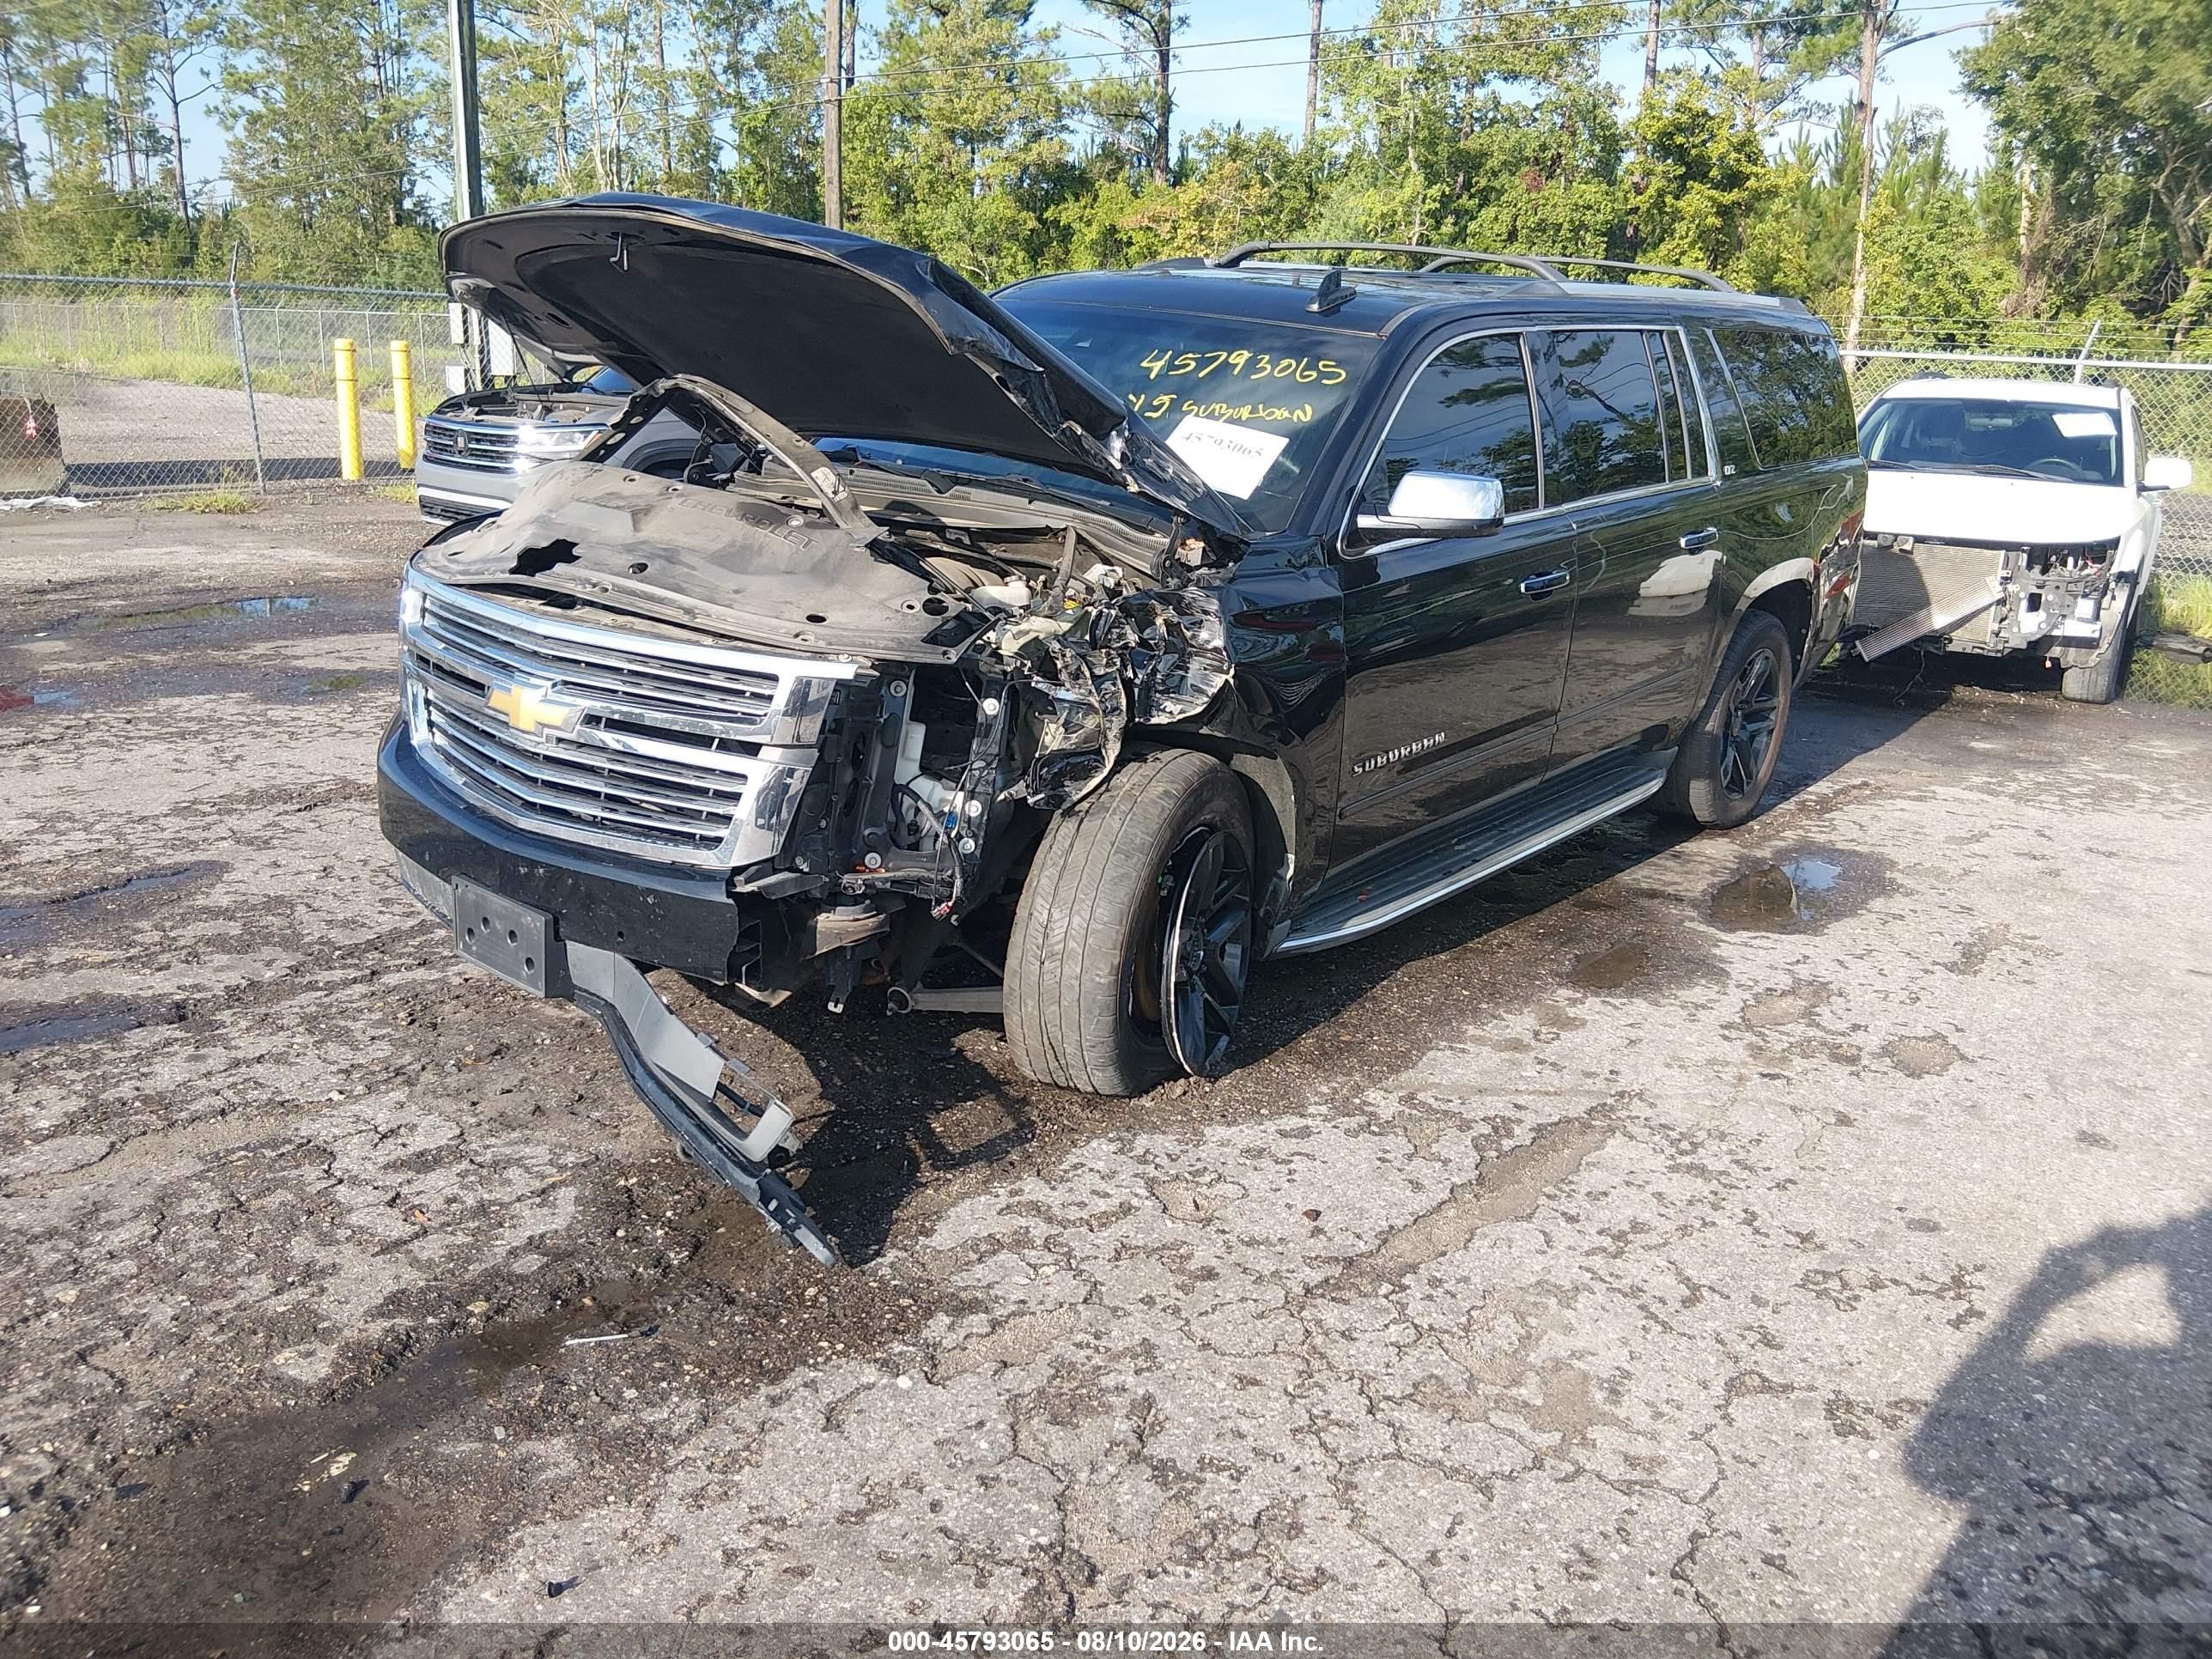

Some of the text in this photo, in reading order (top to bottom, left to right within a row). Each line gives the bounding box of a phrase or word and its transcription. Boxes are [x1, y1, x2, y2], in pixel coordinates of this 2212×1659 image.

[1140, 348, 1346, 385] 45793065
[678, 498, 819, 551] CHEVROLET
[1352, 732, 1445, 777] SUBURBAN
